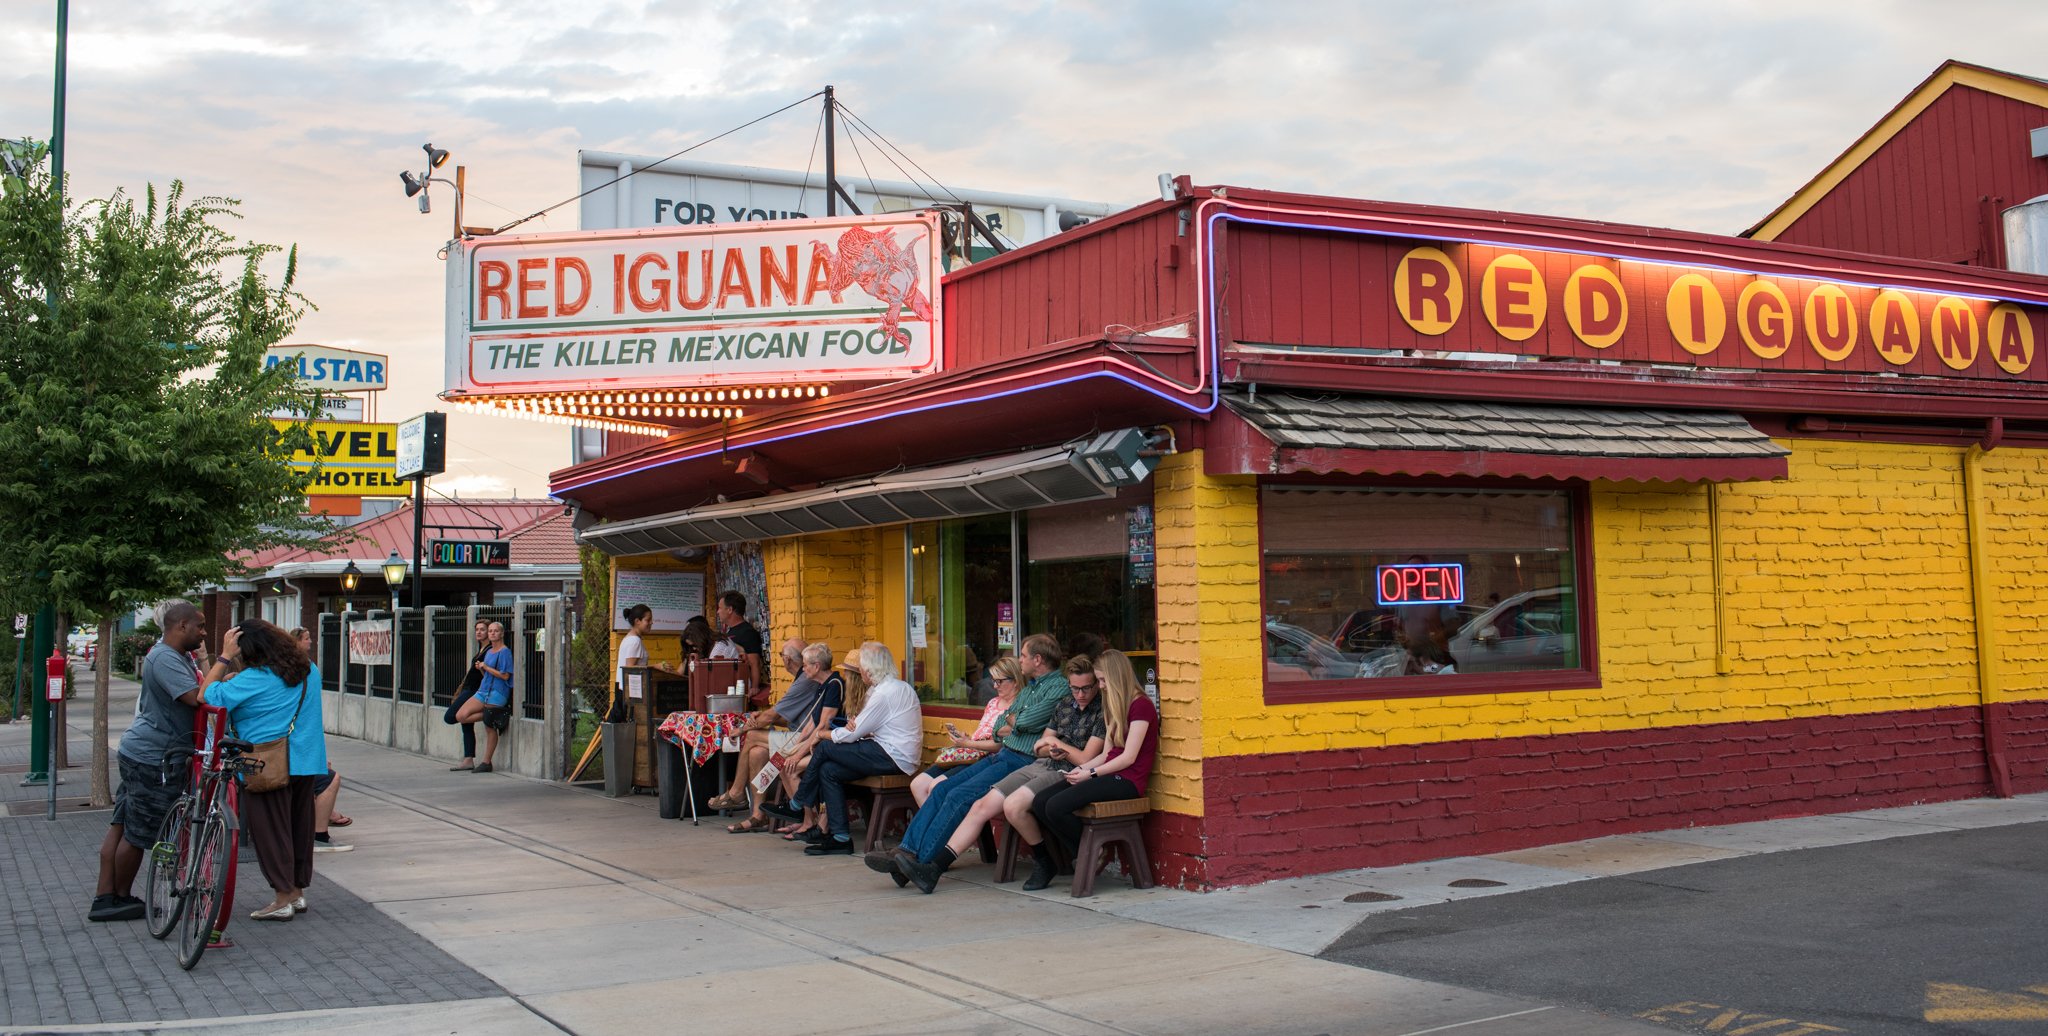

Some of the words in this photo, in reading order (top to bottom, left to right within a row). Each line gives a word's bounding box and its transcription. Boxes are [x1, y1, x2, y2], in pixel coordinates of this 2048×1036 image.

[655, 198, 715, 225] FOR
[479, 256, 592, 320] RED
[613, 244, 844, 314] IGUANA
[1408, 258, 1622, 336] RED
[1690, 285, 2028, 365] IGUANA
[487, 343, 543, 370] THE
[553, 337, 656, 367] KILLER
[667, 331, 810, 362] MEXICAN
[820, 327, 913, 356] FOOD
[433, 543, 472, 564] COLOR
[475, 544, 491, 564] TV
[1381, 567, 1460, 601] OPEN
